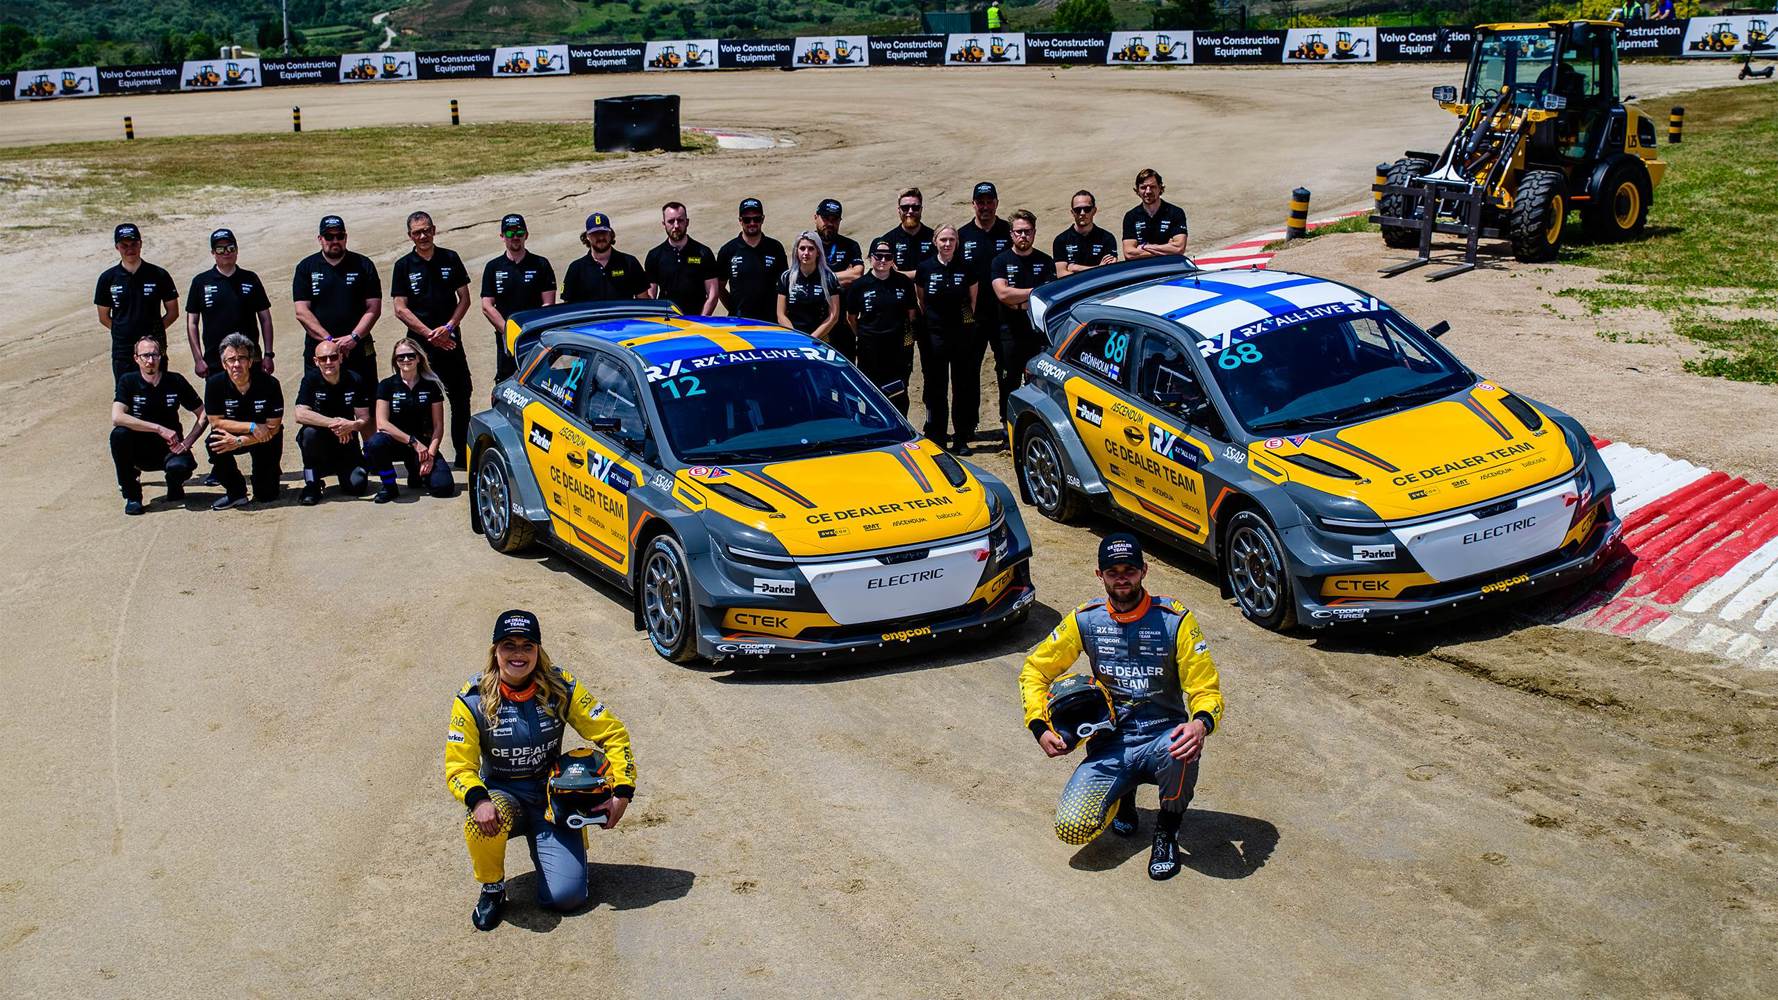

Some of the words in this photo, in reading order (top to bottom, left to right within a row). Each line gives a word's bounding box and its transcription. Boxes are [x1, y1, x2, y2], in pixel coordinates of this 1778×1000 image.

[1027, 38, 1050, 47] Volvo
[1051, 38, 1104, 47] Construction
[1196, 36, 1220, 45] Volvo
[1221, 36, 1280, 45] Construction
[1380, 33, 1405, 43] Volvo
[1407, 31, 1471, 42] Consttion
[720, 45, 742, 53] Volvo
[743, 43, 790, 52] Construction
[870, 41, 892, 49] Volvo
[893, 40, 943, 49] Construction
[571, 49, 592, 58] Volvo
[593, 48, 641, 57] Construction
[736, 53, 776, 63] Equipment
[886, 50, 928, 60] Equipment
[1044, 48, 1088, 58] Equipment
[1214, 46, 1262, 57] Equipment
[263, 61, 286, 71] Volvo
[286, 59, 337, 70] Construction
[418, 55, 439, 65] Volvo
[440, 53, 490, 64] Construction
[587, 58, 627, 68] Equipment
[101, 70, 123, 81] Volvo
[124, 68, 177, 79] Construction
[280, 69, 322, 80] Equipment
[435, 63, 476, 74] Equipment
[118, 75, 162, 88] Equipment
[1275, 312, 1308, 327] ALL
[1309, 303, 1345, 318] LIVE
[1104, 331, 1127, 363] 68
[729, 350, 764, 363] ALL
[764, 347, 801, 360] LIVE
[1218, 342, 1263, 370] 68
[1037, 359, 1070, 381] engcon
[661, 375, 706, 399] 12
[502, 387, 532, 409] engcon
[1222, 446, 1247, 464] SSAB
[1104, 438, 1119, 457] CE
[1119, 445, 1162, 477] DEALER
[1163, 465, 1197, 495] TEAM
[1392, 474, 1419, 487] CE
[1420, 455, 1488, 480] DEALER
[1487, 442, 1535, 461] TEAM
[652, 474, 674, 492] SSAB
[550, 465, 561, 483] CE
[562, 472, 597, 505] DEALER
[597, 491, 625, 521] TEAM
[806, 513, 833, 525] CE
[834, 504, 904, 521] DEALER
[904, 496, 953, 513] TEAM
[1462, 516, 1537, 545] ELECTRIC
[1361, 549, 1395, 559] Parker
[867, 568, 945, 590] ELECTRIC
[1335, 580, 1391, 591] CTEK
[1481, 572, 1530, 594] engcon
[762, 583, 795, 595] Parker
[735, 613, 789, 629] CTEK
[881, 625, 932, 643] engcon
[1099, 664, 1113, 675] CE
[1114, 666, 1164, 677] DEALER
[1114, 677, 1149, 690] TEAM
[491, 748, 509, 758] CE
